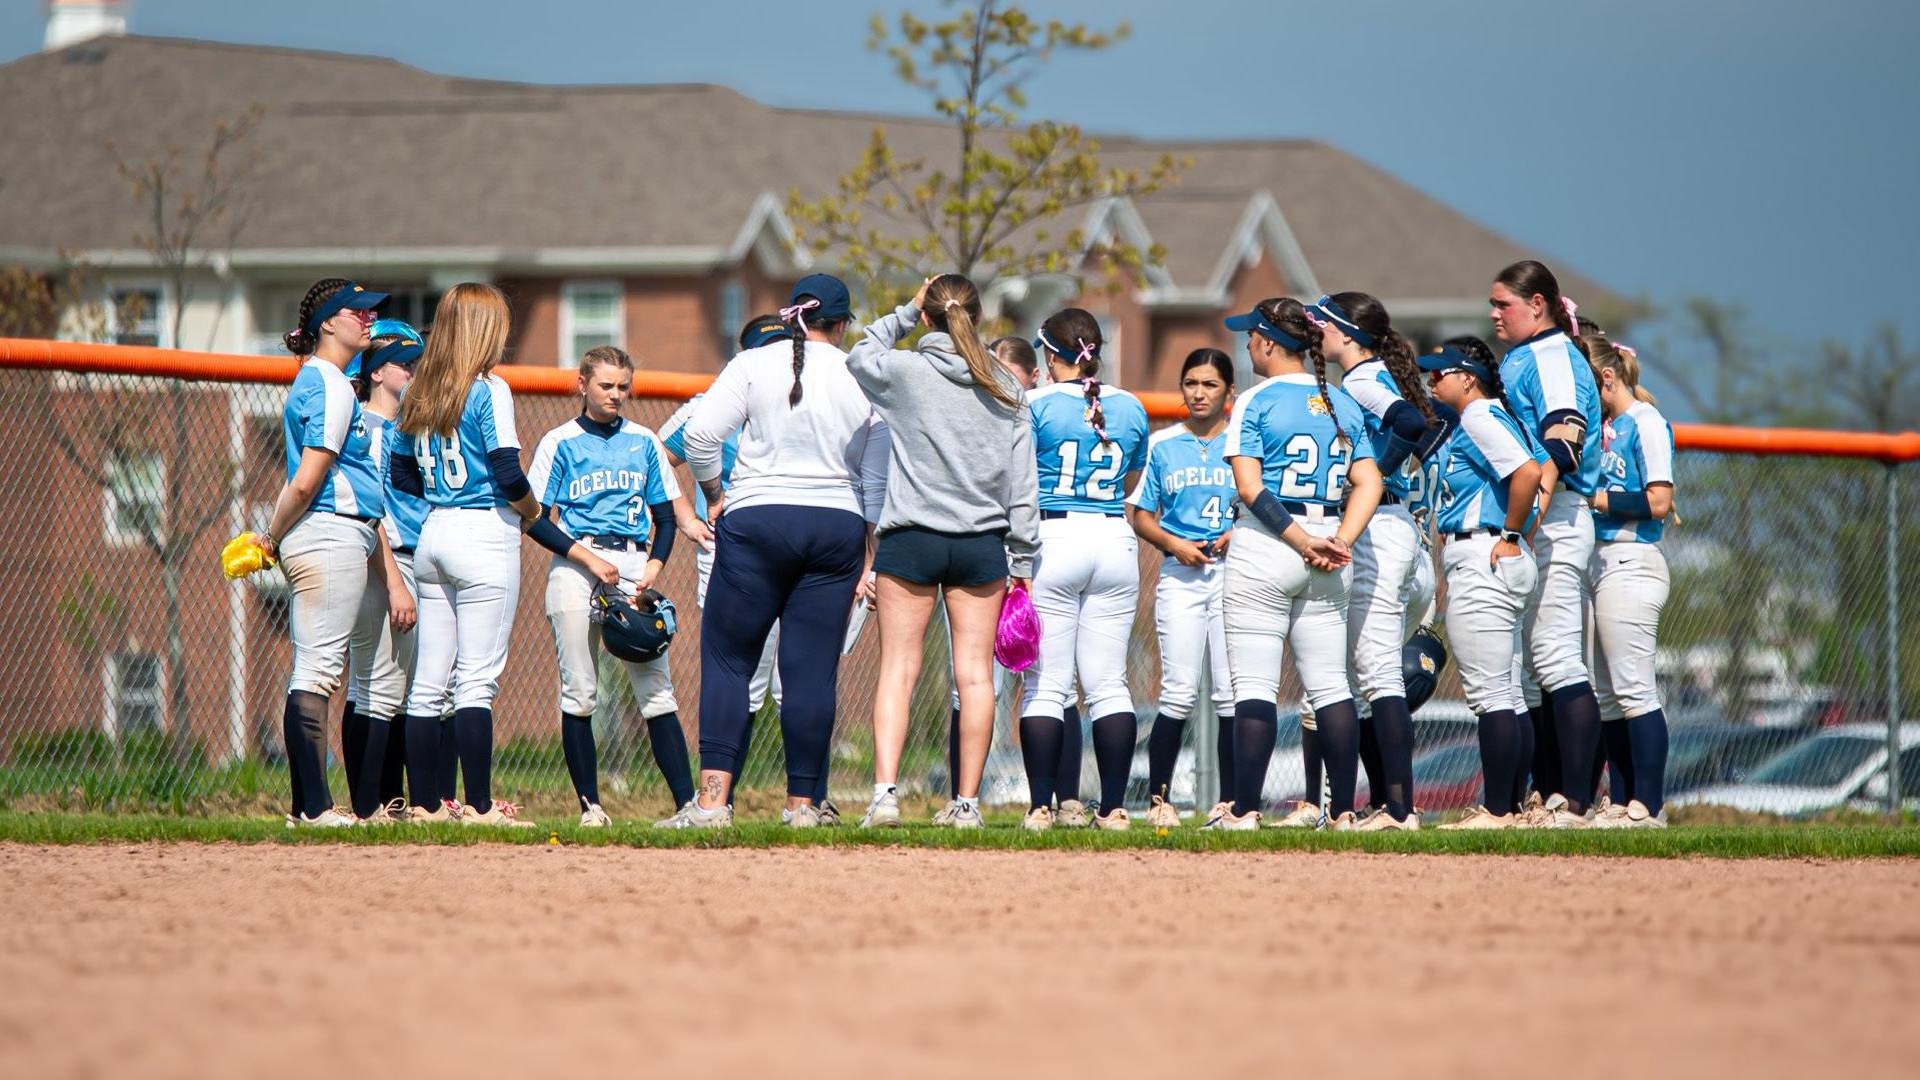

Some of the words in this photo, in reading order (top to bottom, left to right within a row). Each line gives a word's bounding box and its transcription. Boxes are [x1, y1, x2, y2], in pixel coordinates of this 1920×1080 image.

[414, 424, 469, 489] 48
[1052, 440, 1124, 500] 12
[1280, 434, 1354, 500] 22
[569, 469, 647, 501] OCELOT
[1165, 465, 1237, 496] OCELOT
[626, 495, 644, 527] 2
